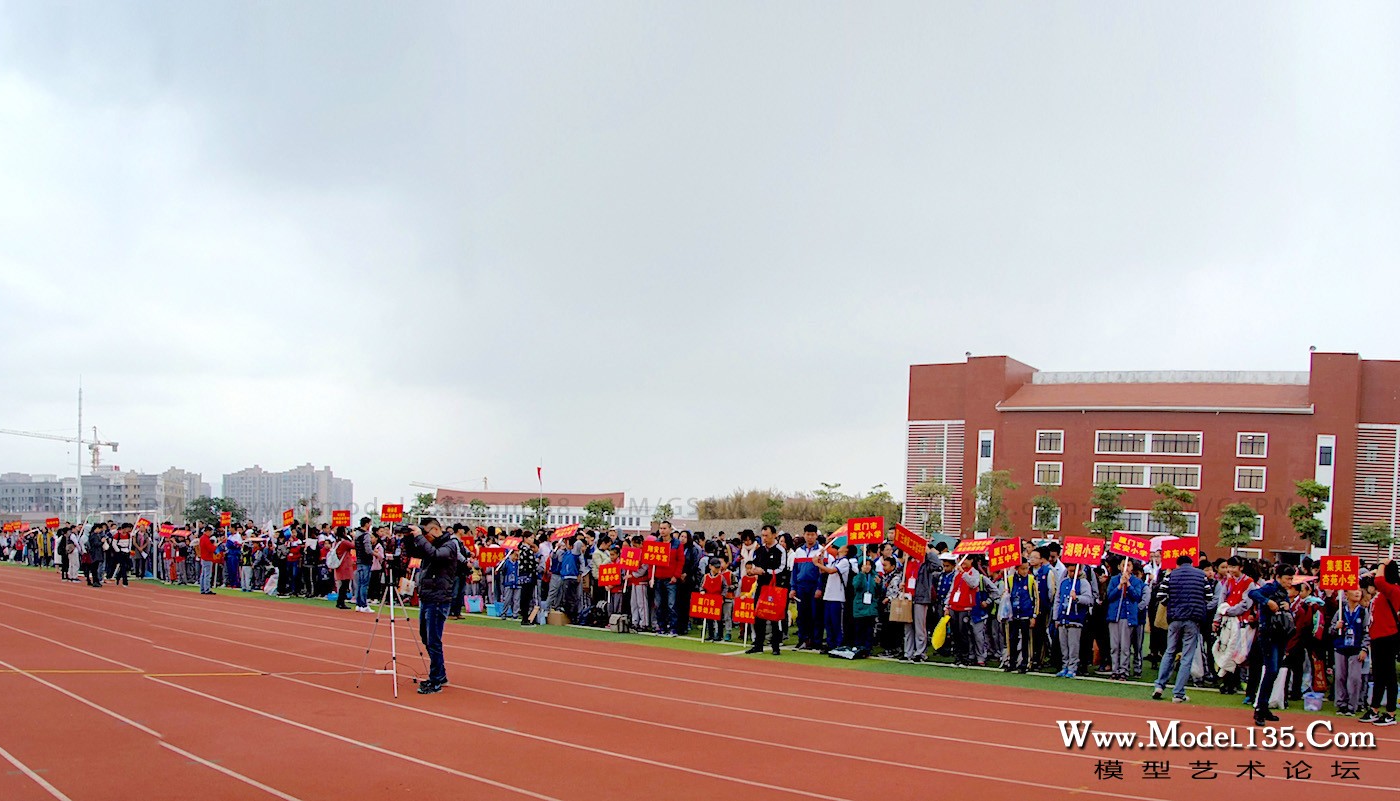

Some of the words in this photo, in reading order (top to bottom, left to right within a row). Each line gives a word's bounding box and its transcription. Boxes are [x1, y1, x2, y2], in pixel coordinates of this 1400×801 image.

[853, 522, 878, 531] 厦门市
[1327, 559, 1352, 572] 集美区
